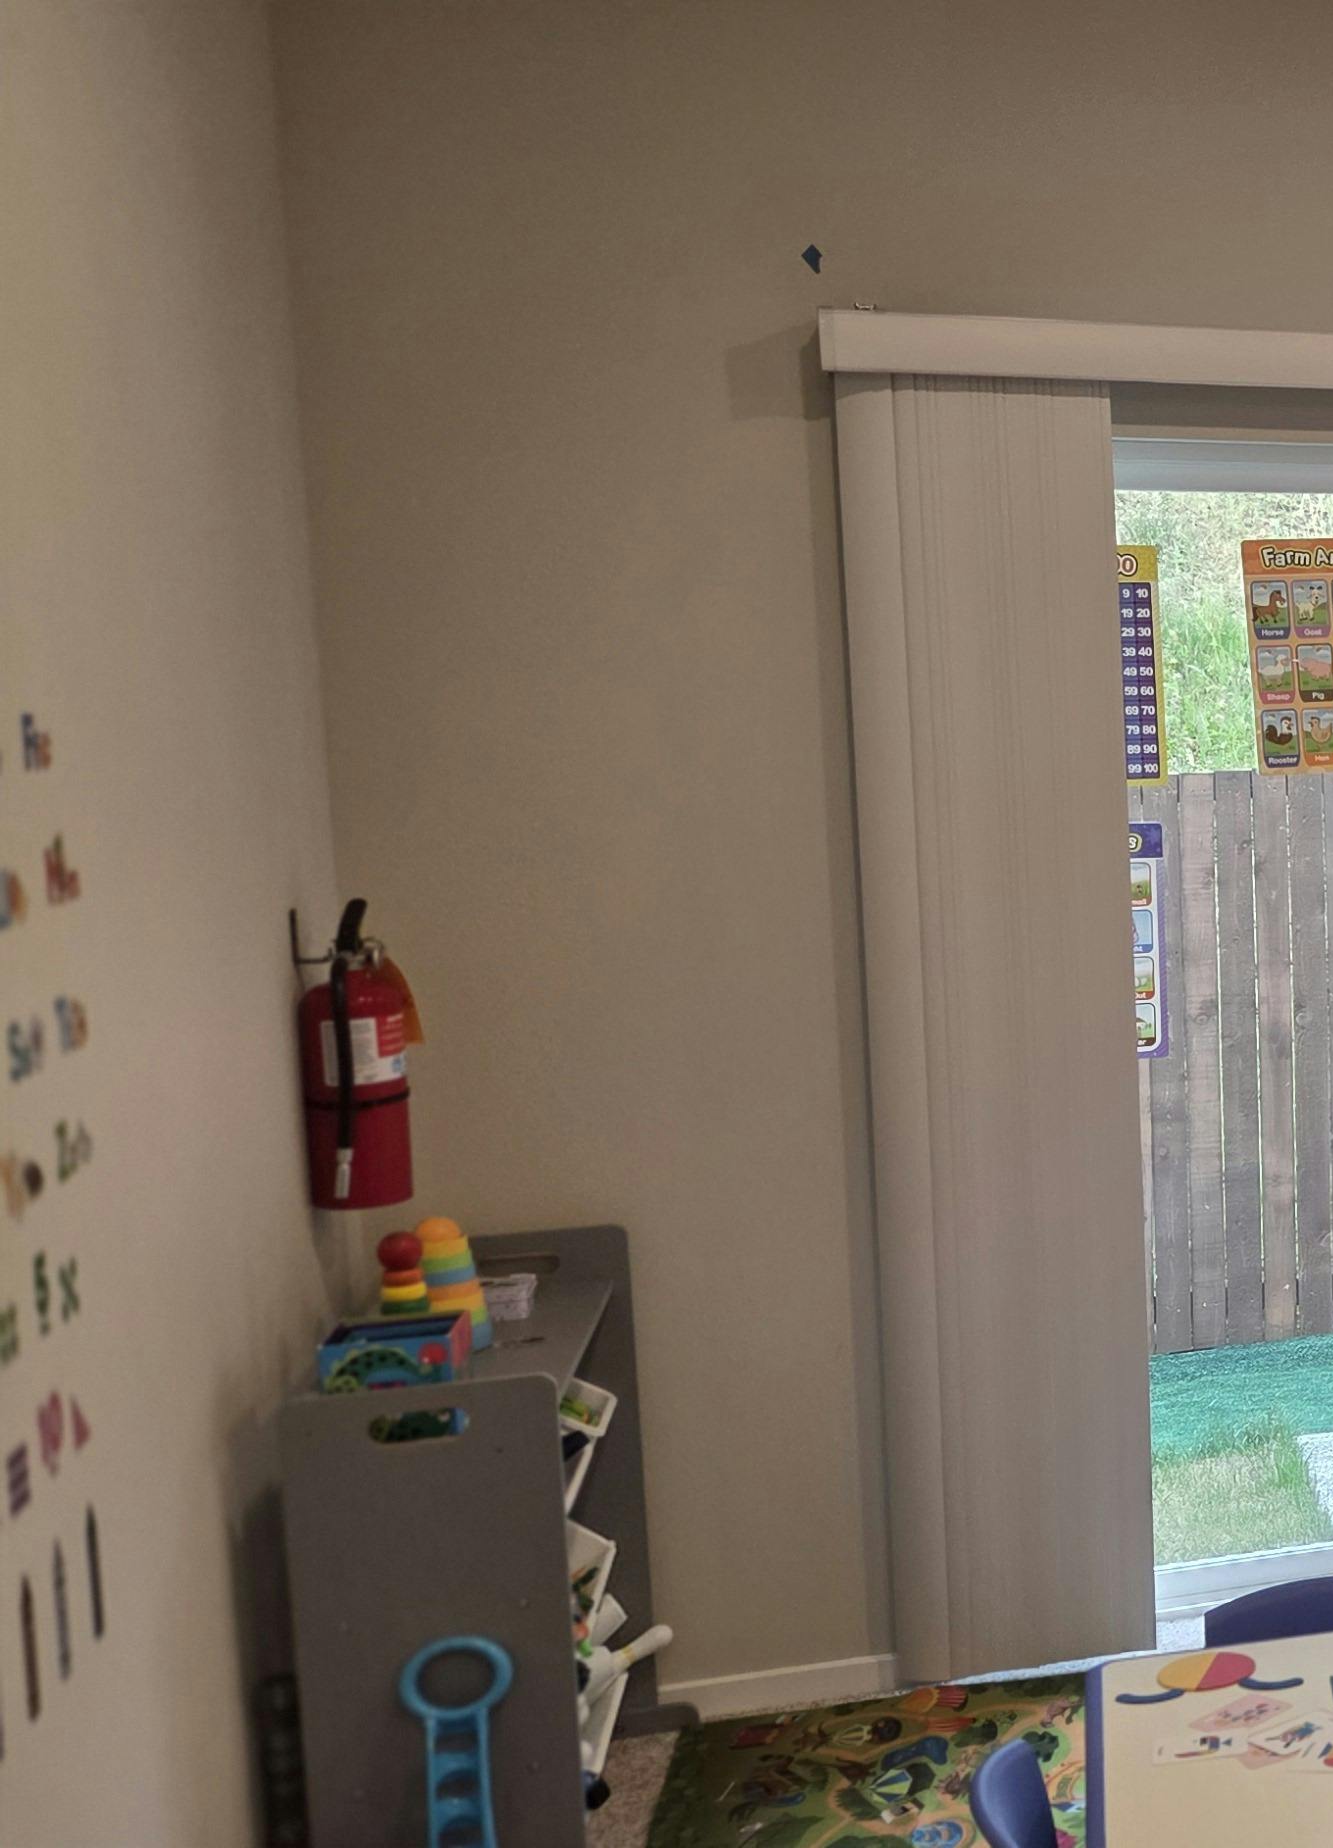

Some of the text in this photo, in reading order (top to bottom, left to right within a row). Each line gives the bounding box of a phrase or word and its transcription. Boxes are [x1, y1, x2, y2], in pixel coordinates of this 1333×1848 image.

[1262, 547, 1311, 567] Farm
[1123, 589, 1148, 598] 9 10
[1122, 608, 1150, 617] 19 20
[1122, 628, 1151, 636] 29 30
[1123, 647, 1152, 656] 39 40
[1124, 667, 1153, 676] 49 50
[1125, 686, 1154, 695] 59 60
[1312, 692, 1325, 700] Pig
[1125, 706, 1155, 715] 69 70
[1126, 725, 1156, 734] 79 80
[1127, 745, 1157, 753] 89 90
[1128, 764, 1158, 772] 99 100
